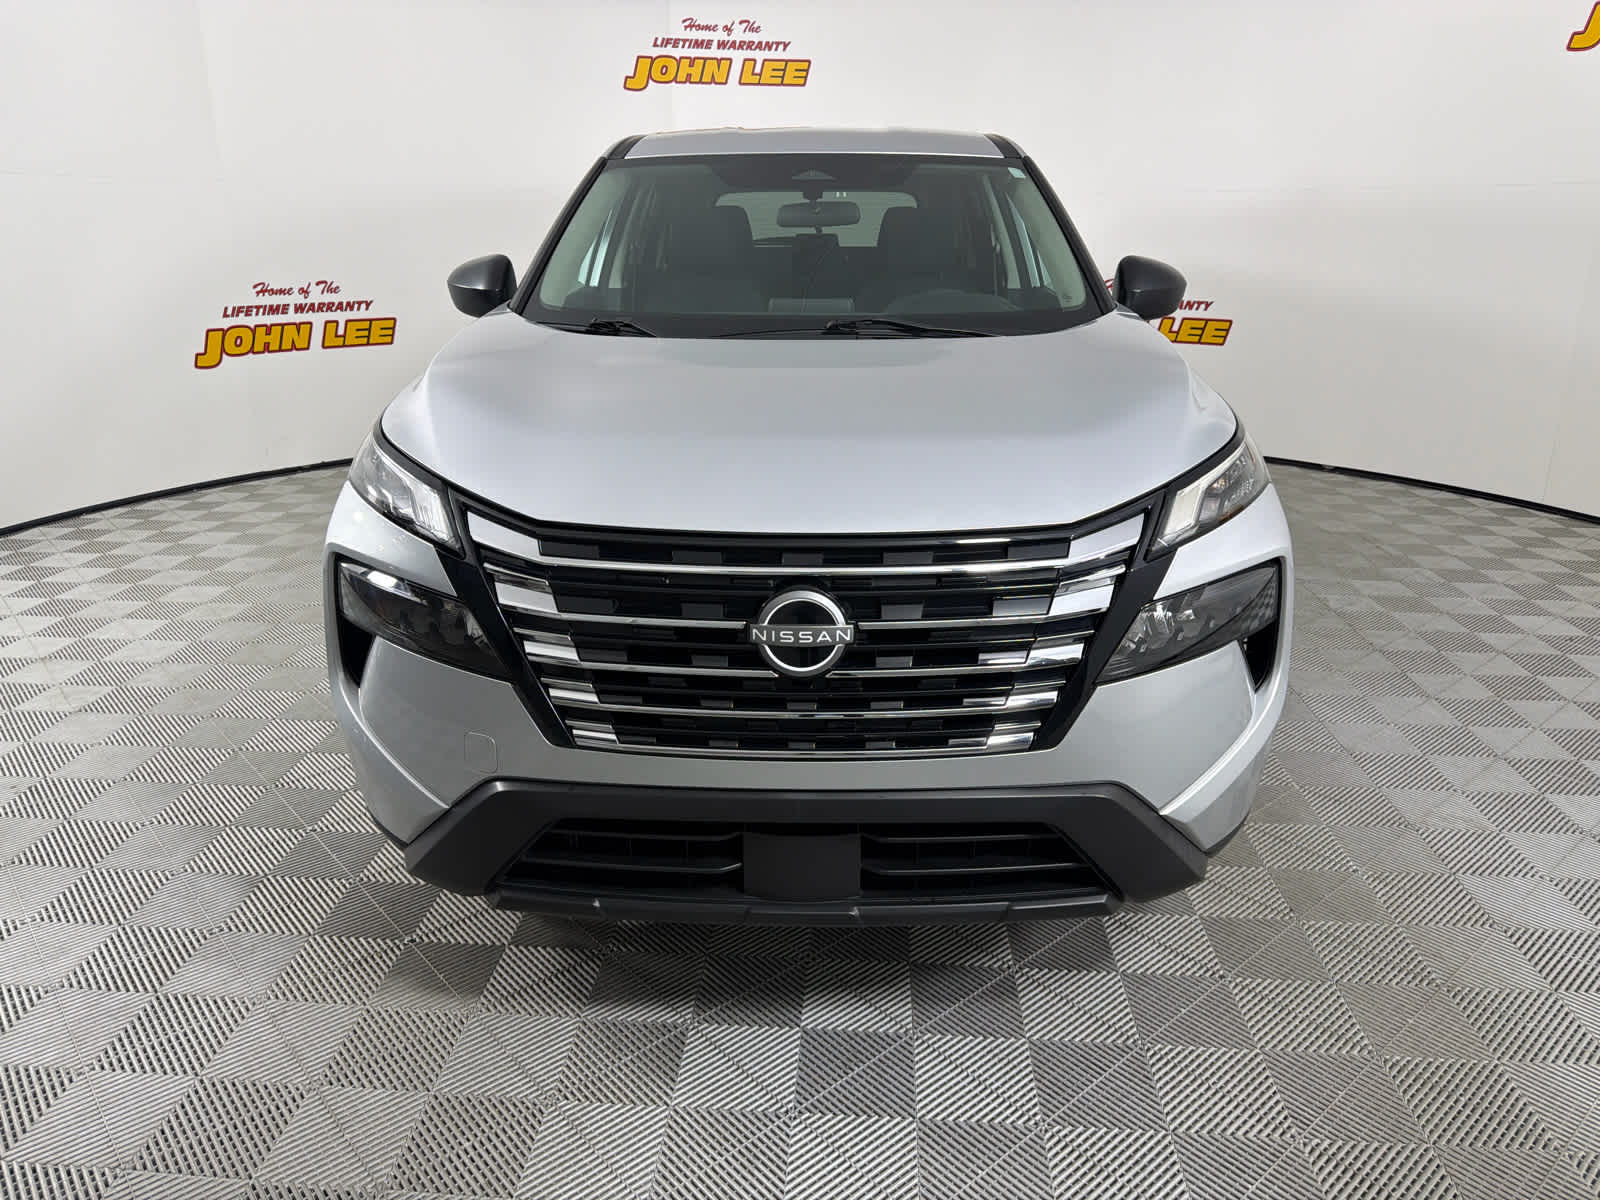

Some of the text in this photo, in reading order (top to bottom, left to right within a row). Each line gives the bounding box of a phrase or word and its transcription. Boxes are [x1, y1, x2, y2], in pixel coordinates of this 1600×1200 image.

[682, 17, 762, 36] Home of The
[653, 37, 791, 52] LIFETIME WARRANTY
[624, 55, 811, 92] JOHN LEE
[252, 280, 341, 299] Home of The
[222, 300, 374, 318] LIFETIME WARRANTY
[1158, 316, 1233, 346] LEE
[194, 317, 397, 369] JOHN LEE
[752, 628, 851, 643] NISSAN
